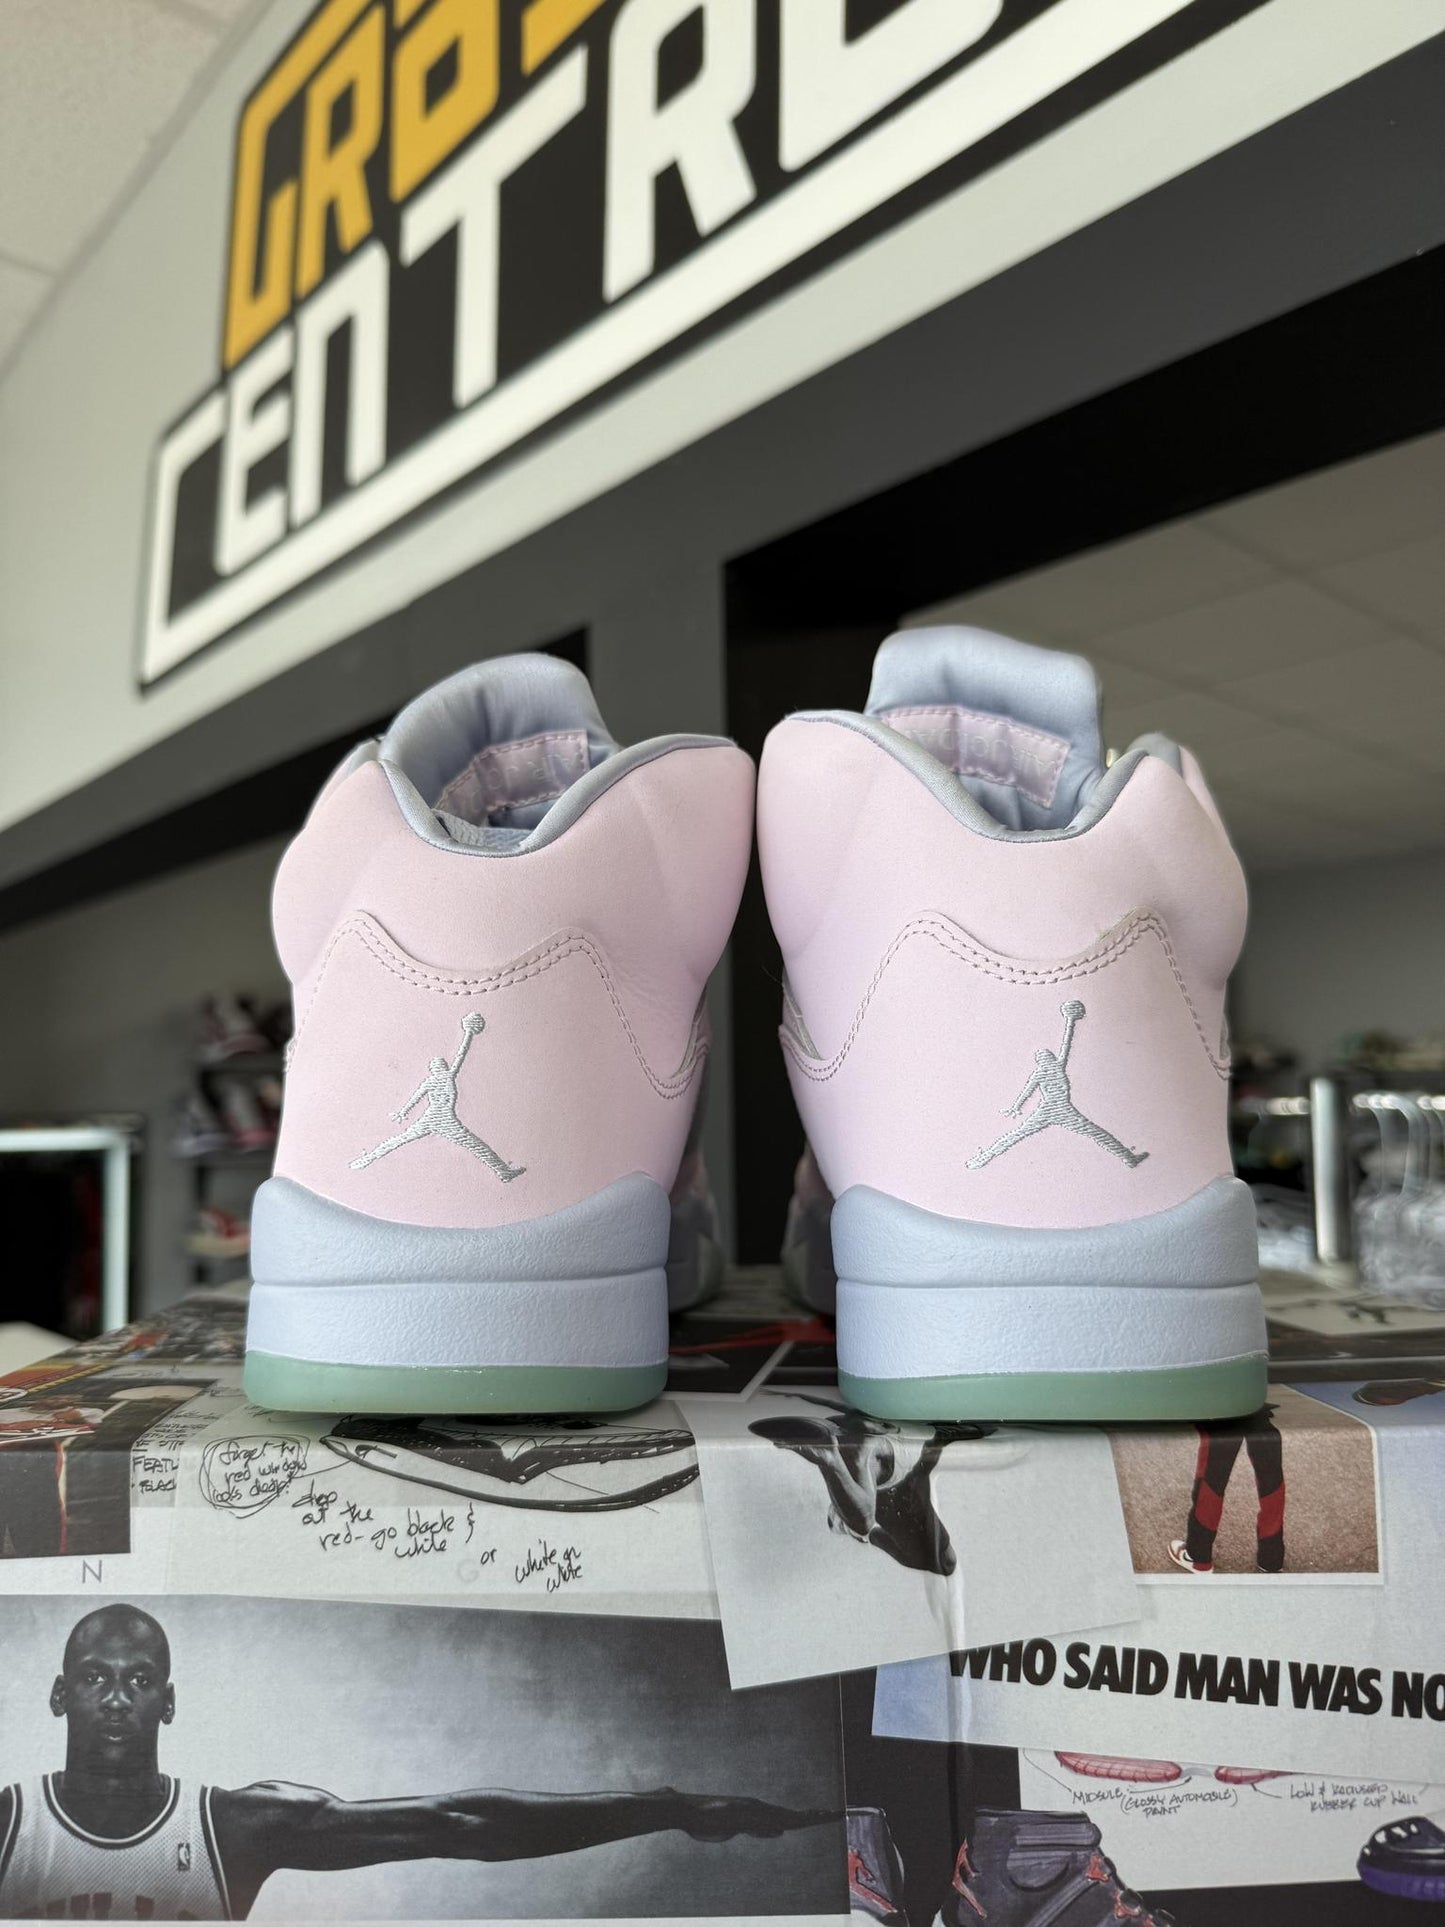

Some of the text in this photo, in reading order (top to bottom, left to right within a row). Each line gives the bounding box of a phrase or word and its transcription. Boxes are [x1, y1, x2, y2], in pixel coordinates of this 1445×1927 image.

[340, 1501, 374, 1523] the
[407, 1507, 455, 1537] black
[395, 1536, 447, 1559] white
[480, 1548, 497, 1565] or
[515, 1538, 557, 1584] white
[948, 1637, 1057, 1686] WHO
[1063, 1641, 1169, 1697] SAID
[1174, 1652, 1280, 1707] MAN
[1288, 1661, 1383, 1716] WAS
